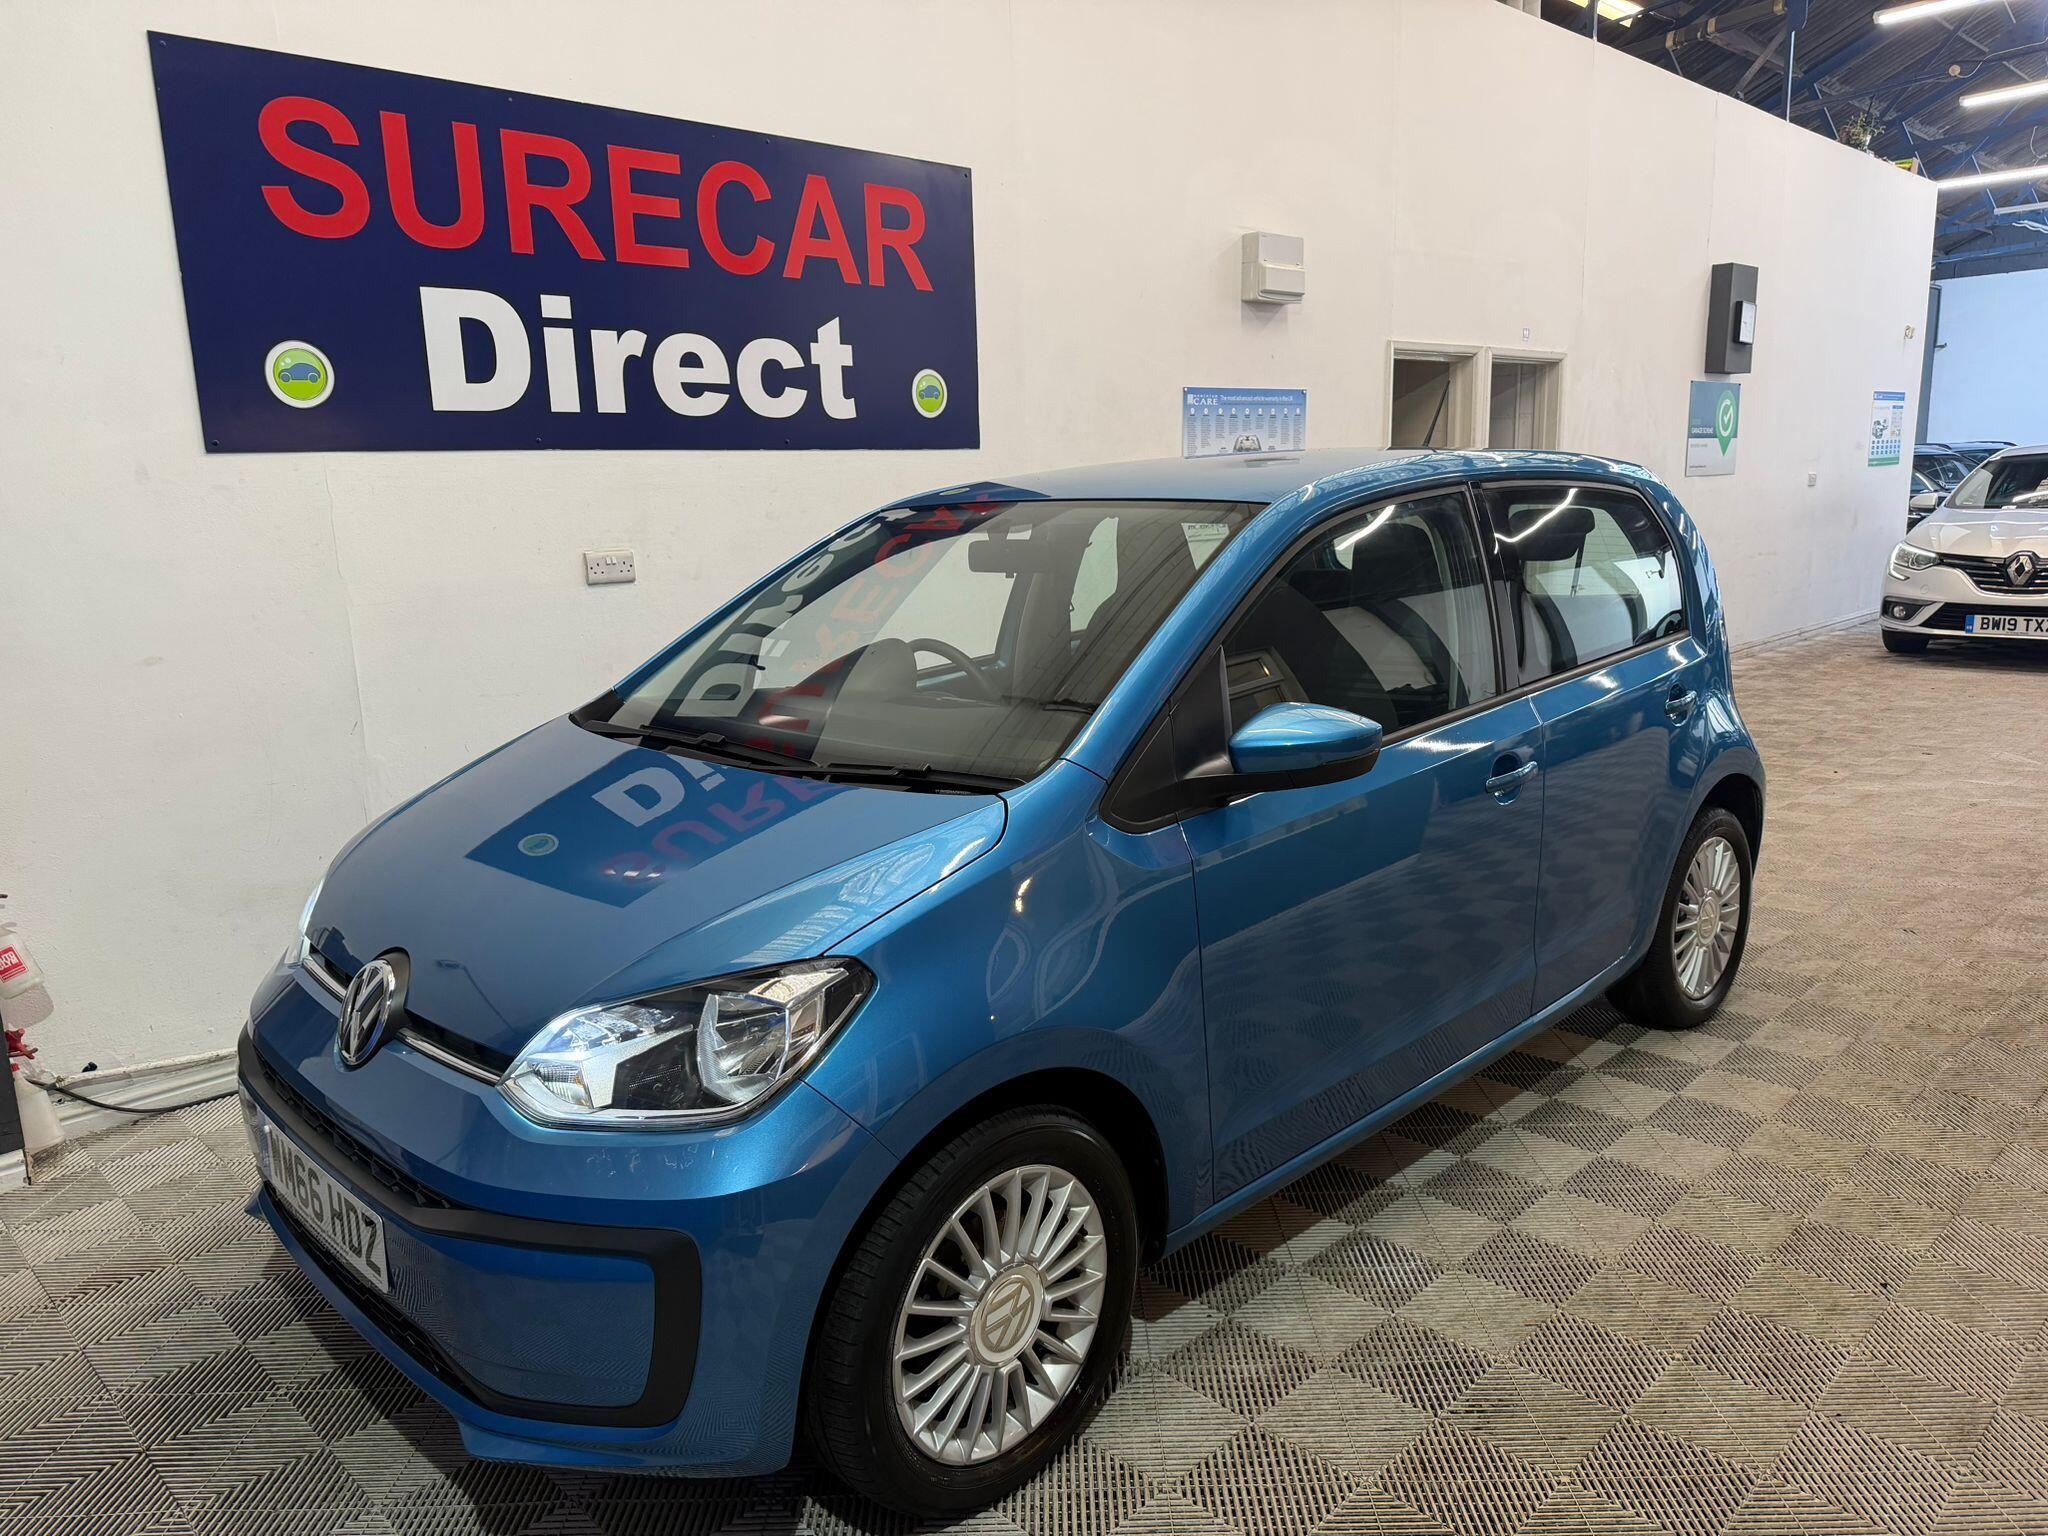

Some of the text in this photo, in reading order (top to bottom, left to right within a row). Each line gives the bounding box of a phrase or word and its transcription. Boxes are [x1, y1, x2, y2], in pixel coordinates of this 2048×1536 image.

[257, 95, 934, 292] SURECAR
[419, 286, 857, 420] Direct
[1980, 616, 2048, 633] BW19 TX
[327, 1183, 382, 1278] HDZ
